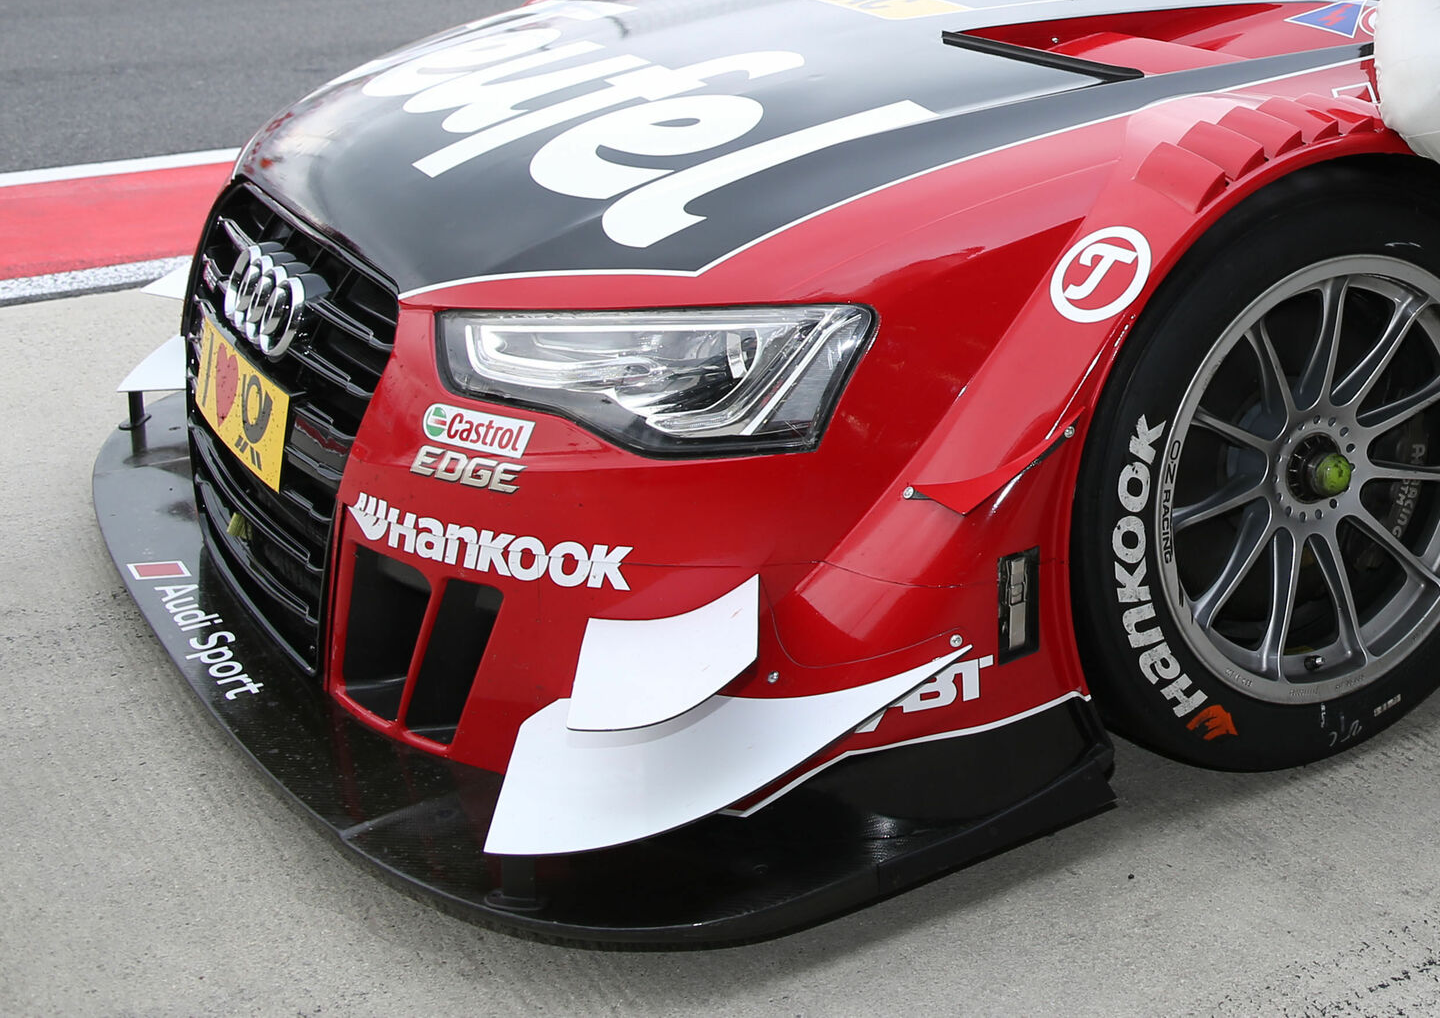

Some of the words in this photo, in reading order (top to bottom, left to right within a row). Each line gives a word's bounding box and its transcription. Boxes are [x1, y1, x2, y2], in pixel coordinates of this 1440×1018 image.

[446, 412, 524, 453] Castrol
[409, 444, 529, 494] EDGE
[1162, 489, 1173, 564] RACING
[154, 585, 224, 632] Audi
[185, 631, 264, 700] Sport
